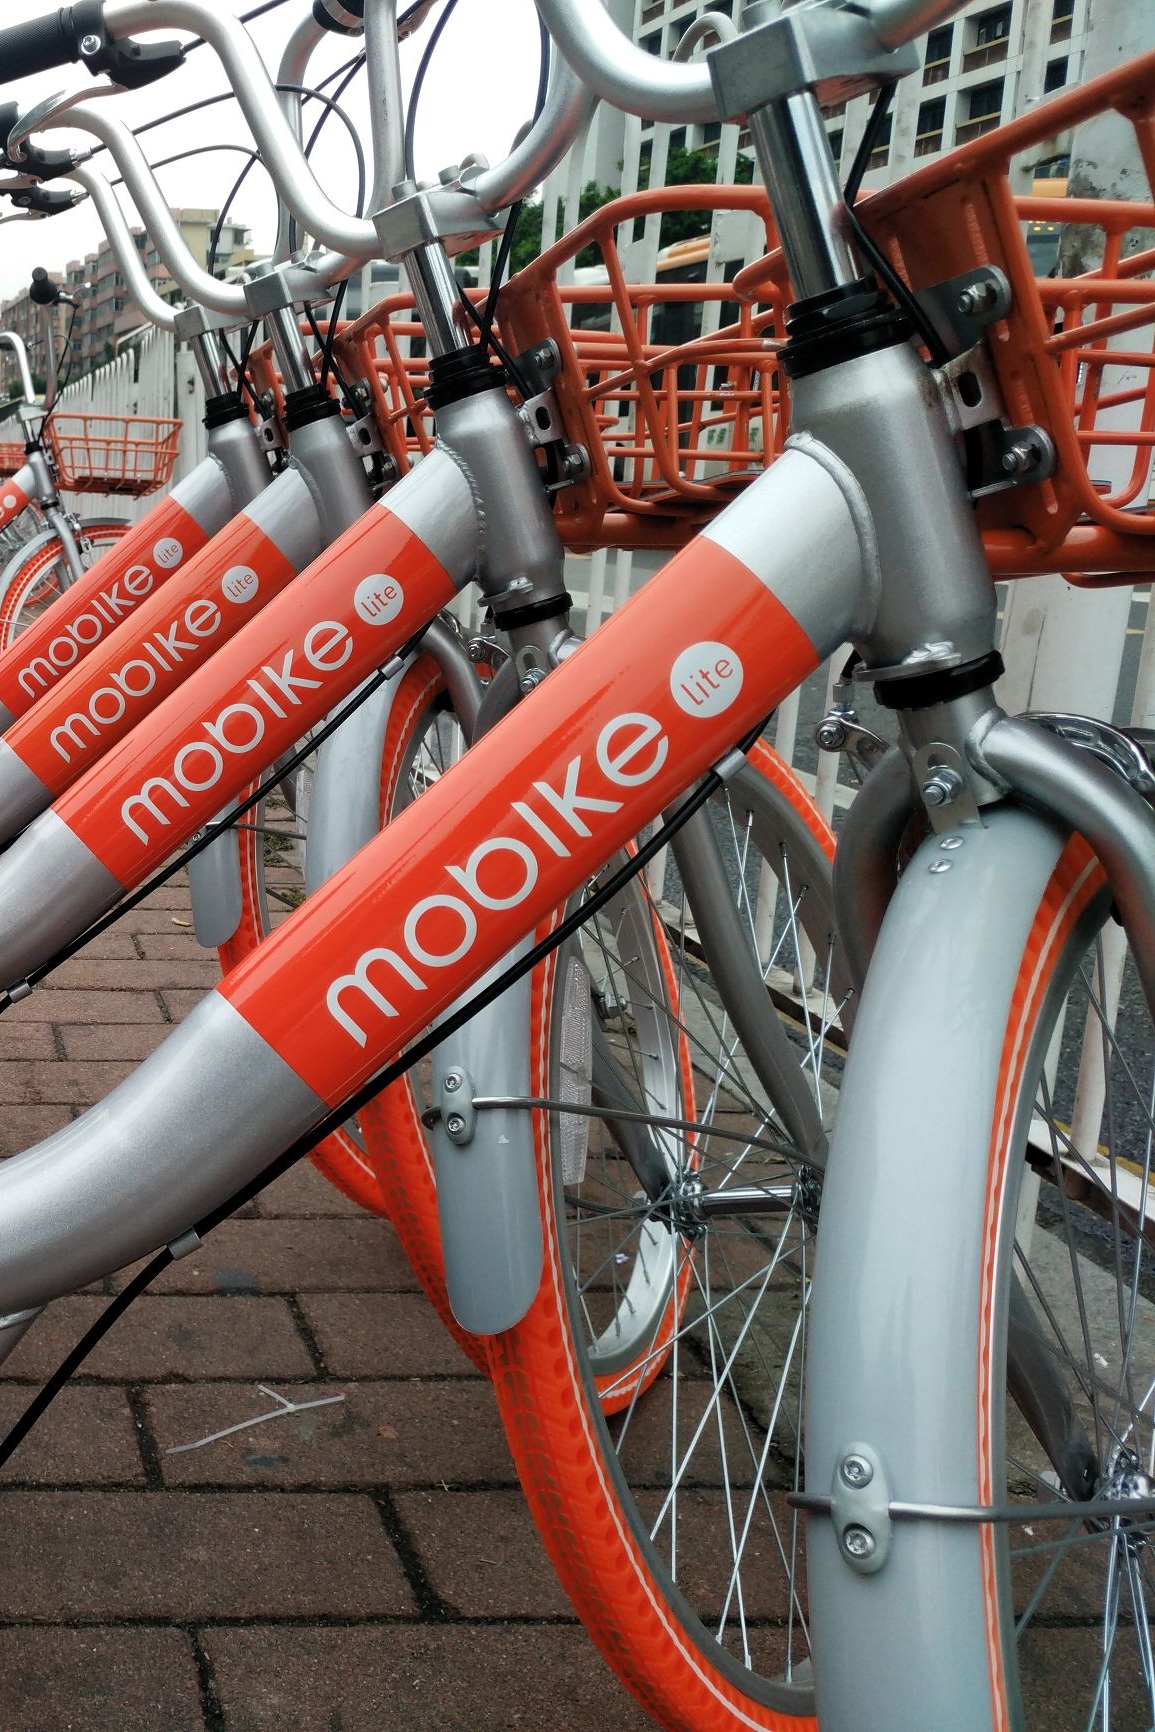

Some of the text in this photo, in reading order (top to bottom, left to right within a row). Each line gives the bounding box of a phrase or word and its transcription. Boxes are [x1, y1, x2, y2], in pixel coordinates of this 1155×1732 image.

[18, 544, 179, 698] mobike lite
[50, 574, 254, 763] mobike lite
[121, 584, 398, 846] mobike lite
[326, 656, 734, 1048] mobike lite
